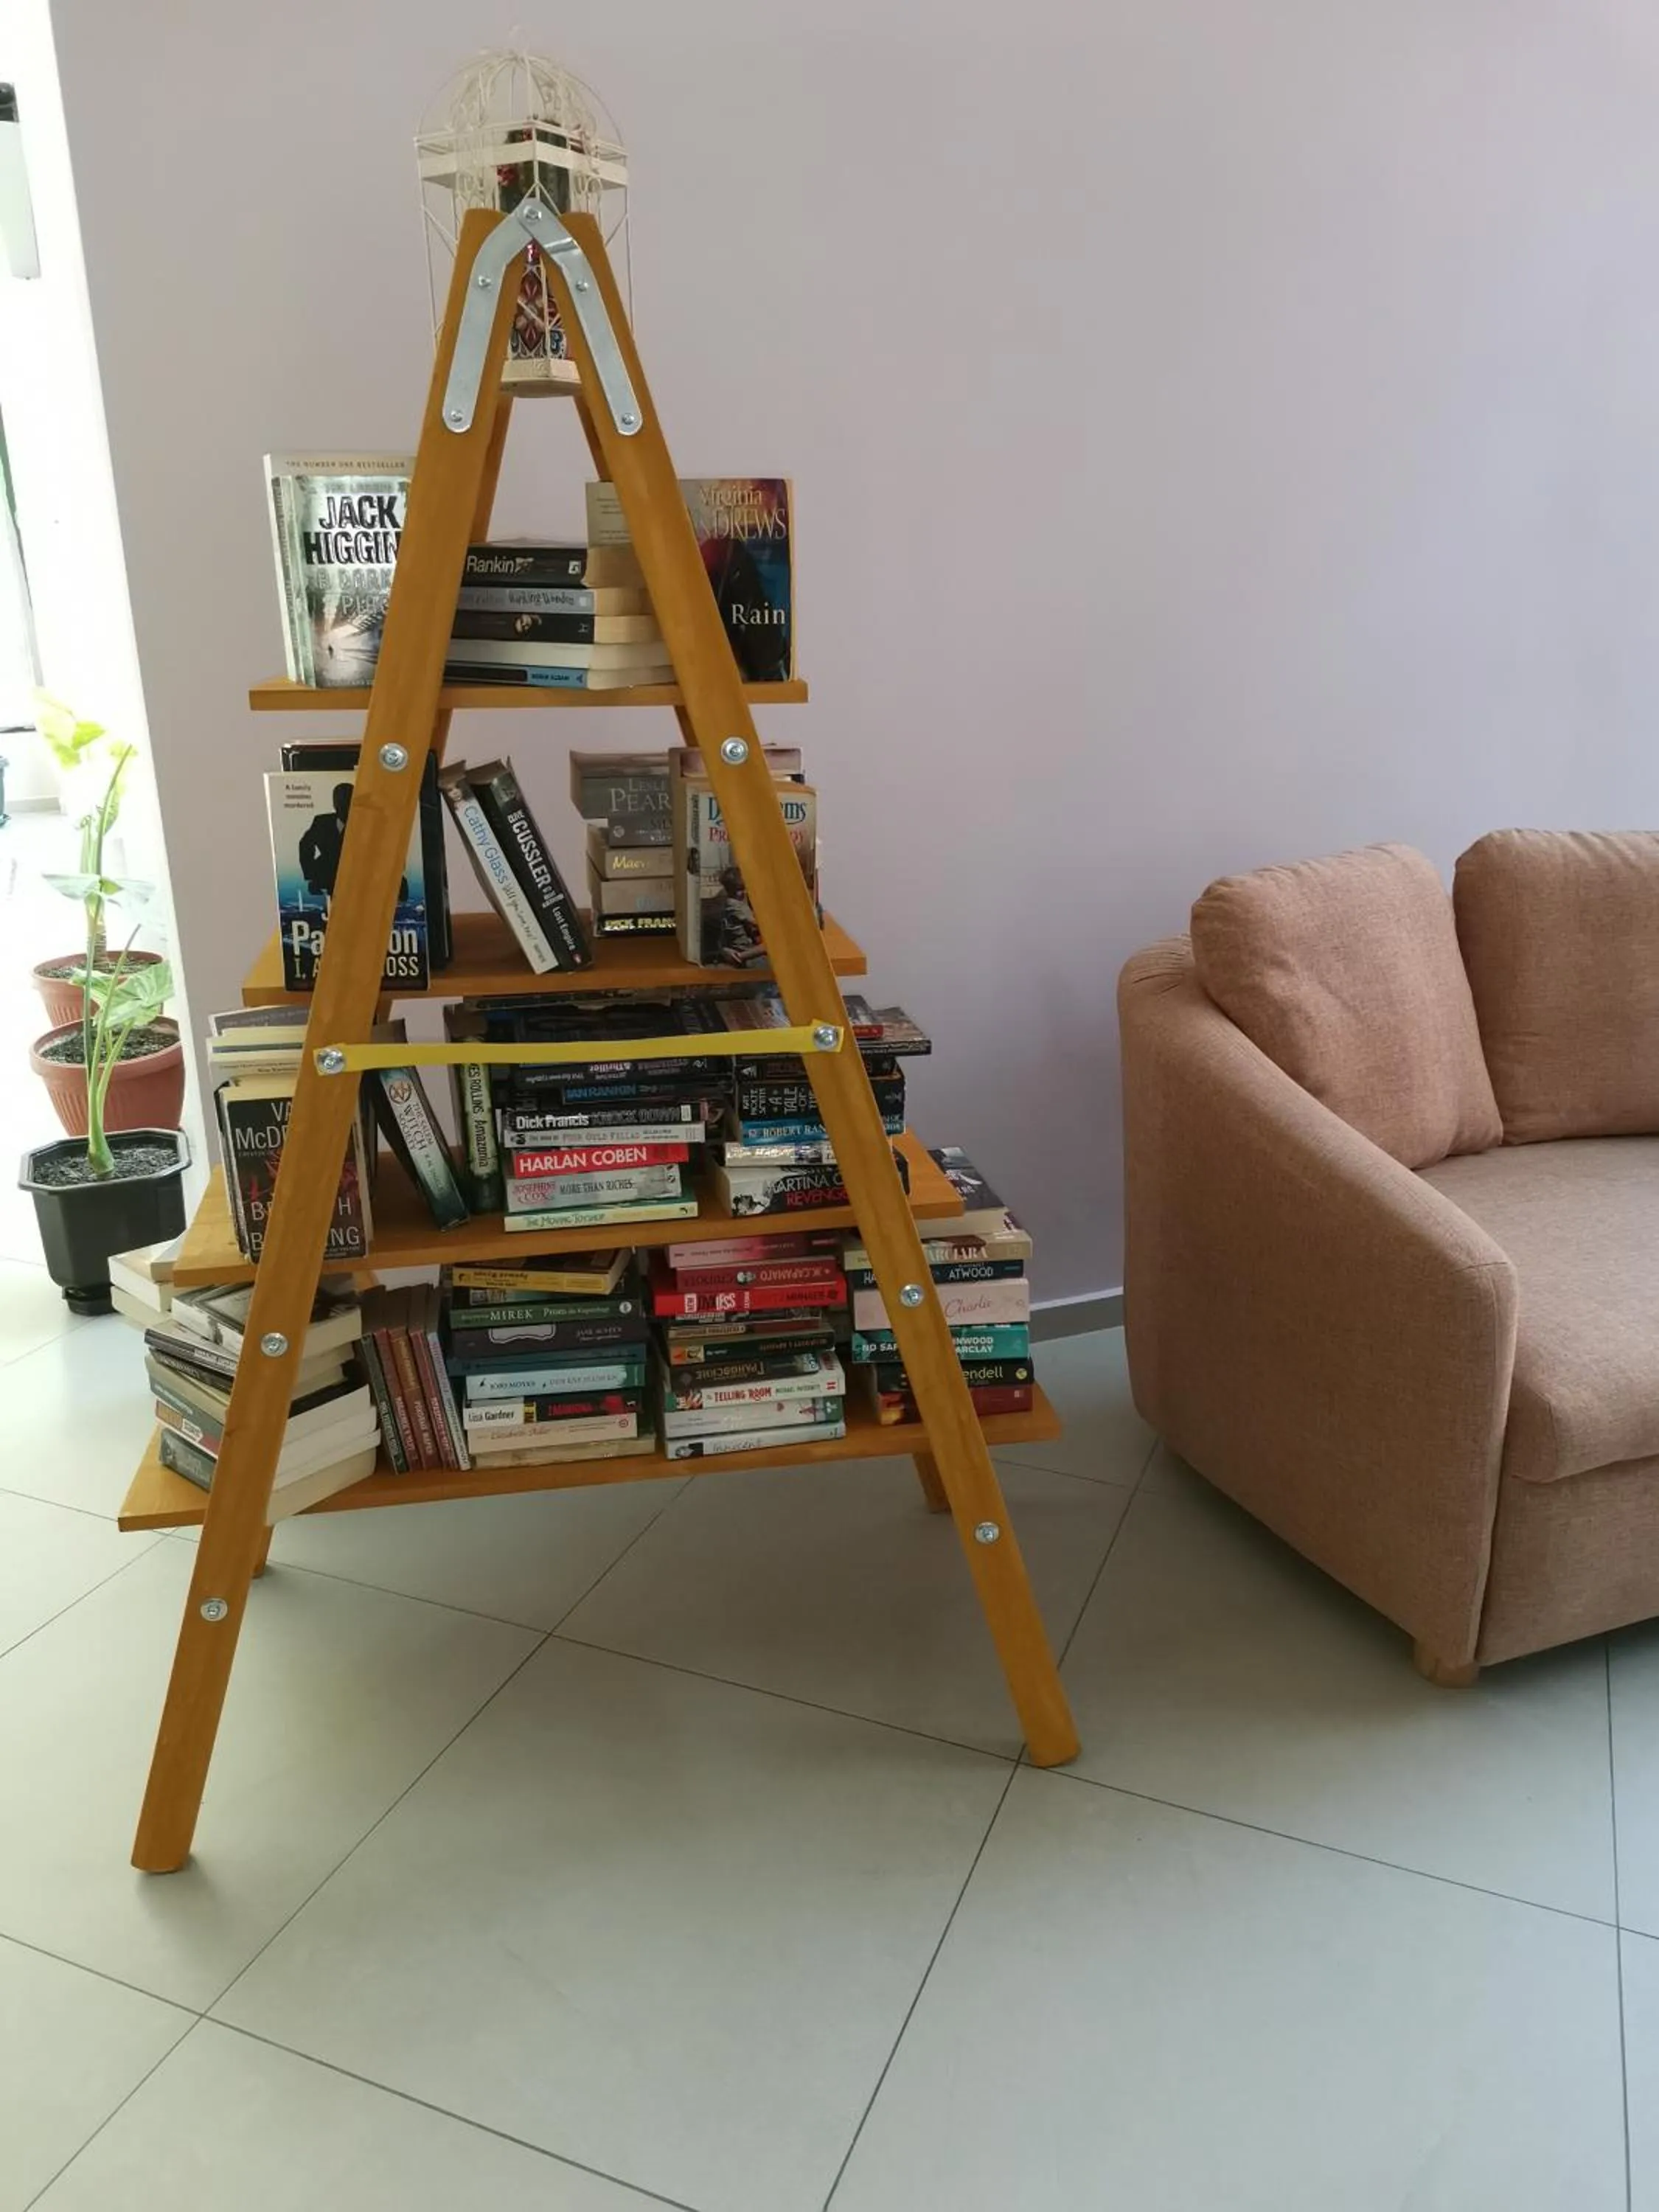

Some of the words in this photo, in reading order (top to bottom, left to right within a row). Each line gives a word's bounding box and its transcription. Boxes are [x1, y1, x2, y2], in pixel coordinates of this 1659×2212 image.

[700, 485, 762, 507] Virginia
[318, 495, 402, 529] JACK
[700, 507, 787, 540] NDREWS
[304, 531, 406, 566] HIGGIN
[466, 555, 515, 574] Rankin
[731, 602, 785, 625] Rain
[609, 787, 672, 812] PEAR
[465, 804, 490, 848] Cathy
[483, 846, 509, 885] Glass
[512, 816, 552, 891] CUSSLER
[401, 1103, 425, 1151] WITCH
[516, 1115, 543, 1130] Dick
[545, 1113, 589, 1128] Francis
[762, 1125, 802, 1138] ROBERT
[804, 1123, 827, 1134] RAN
[473, 1119, 490, 1168] Amazonia
[519, 1152, 588, 1173] HARLAN
[591, 1146, 647, 1165] COBEN
[560, 1183, 581, 1195] MORE
[605, 1179, 634, 1192] RICHES
[948, 1266, 994, 1280] ATWOOD
[489, 1308, 533, 1321] MIREK
[944, 1296, 992, 1318] Charlie
[954, 1336, 994, 1345] NWOOD
[955, 1344, 995, 1354] ARCLAY
[963, 1366, 1004, 1380] endell
[714, 1390, 746, 1402] TELLING
[748, 1387, 772, 1401] ROOM
[467, 1409, 484, 1423] Lisa
[484, 1407, 515, 1421] Gardner
